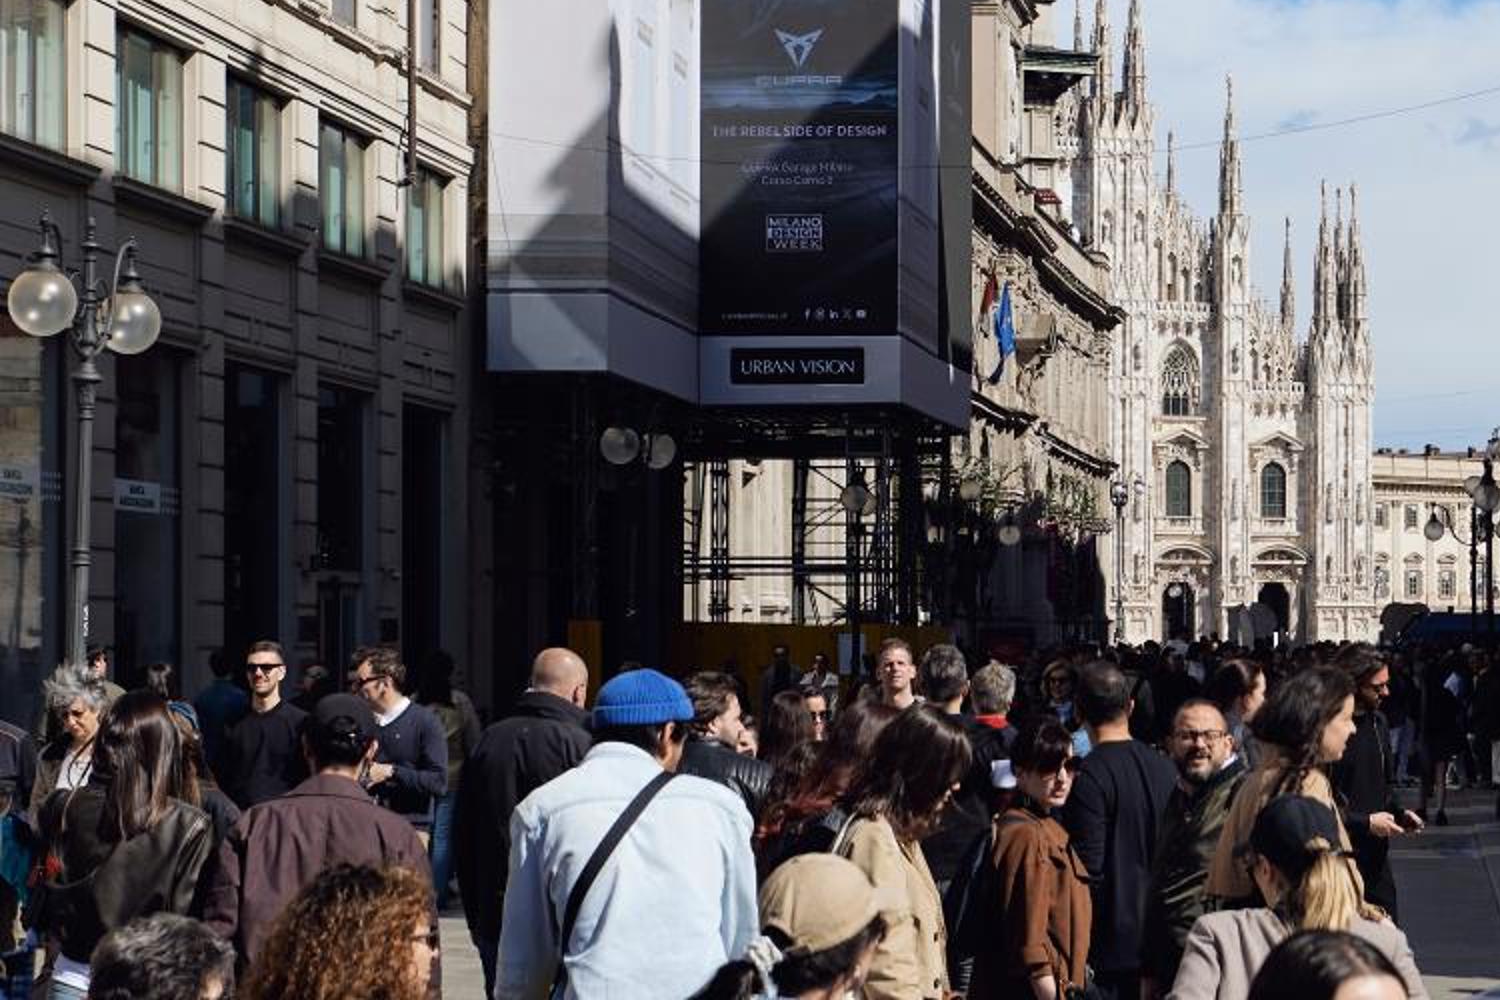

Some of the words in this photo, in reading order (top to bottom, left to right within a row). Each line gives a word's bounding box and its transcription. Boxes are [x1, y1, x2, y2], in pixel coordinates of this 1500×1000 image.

[713, 126, 737, 137] THE
[741, 125, 780, 137] REBEL
[783, 125, 813, 137] SIDE
[815, 125, 834, 137] OF
[837, 125, 887, 137] DESIGN
[769, 217, 822, 228] MILANO
[771, 228, 822, 238] DESIGN
[773, 239, 821, 250] WEEK
[740, 359, 796, 375] URBAN
[799, 359, 856, 375] VISION
